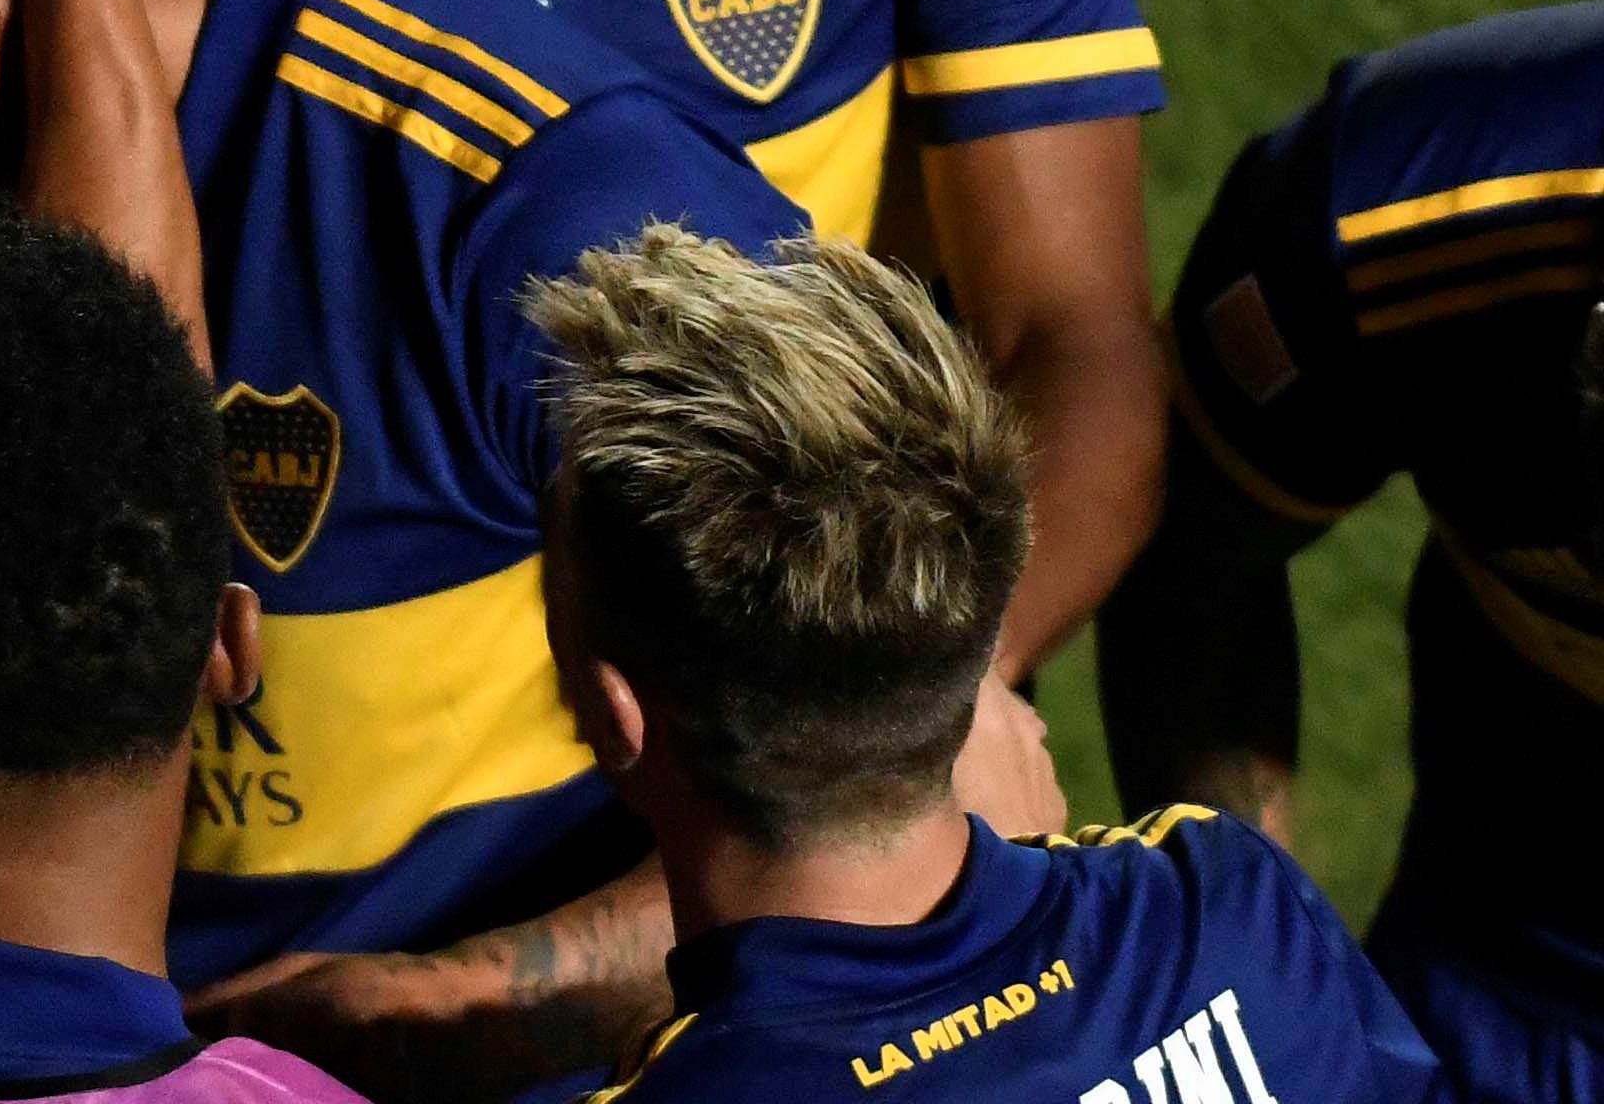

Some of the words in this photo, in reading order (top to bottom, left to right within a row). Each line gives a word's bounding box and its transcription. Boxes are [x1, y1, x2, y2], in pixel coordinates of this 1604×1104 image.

[851, 1043, 915, 1087] LA
[911, 983, 1036, 1061] MITAD
[1039, 959, 1075, 994] +1
